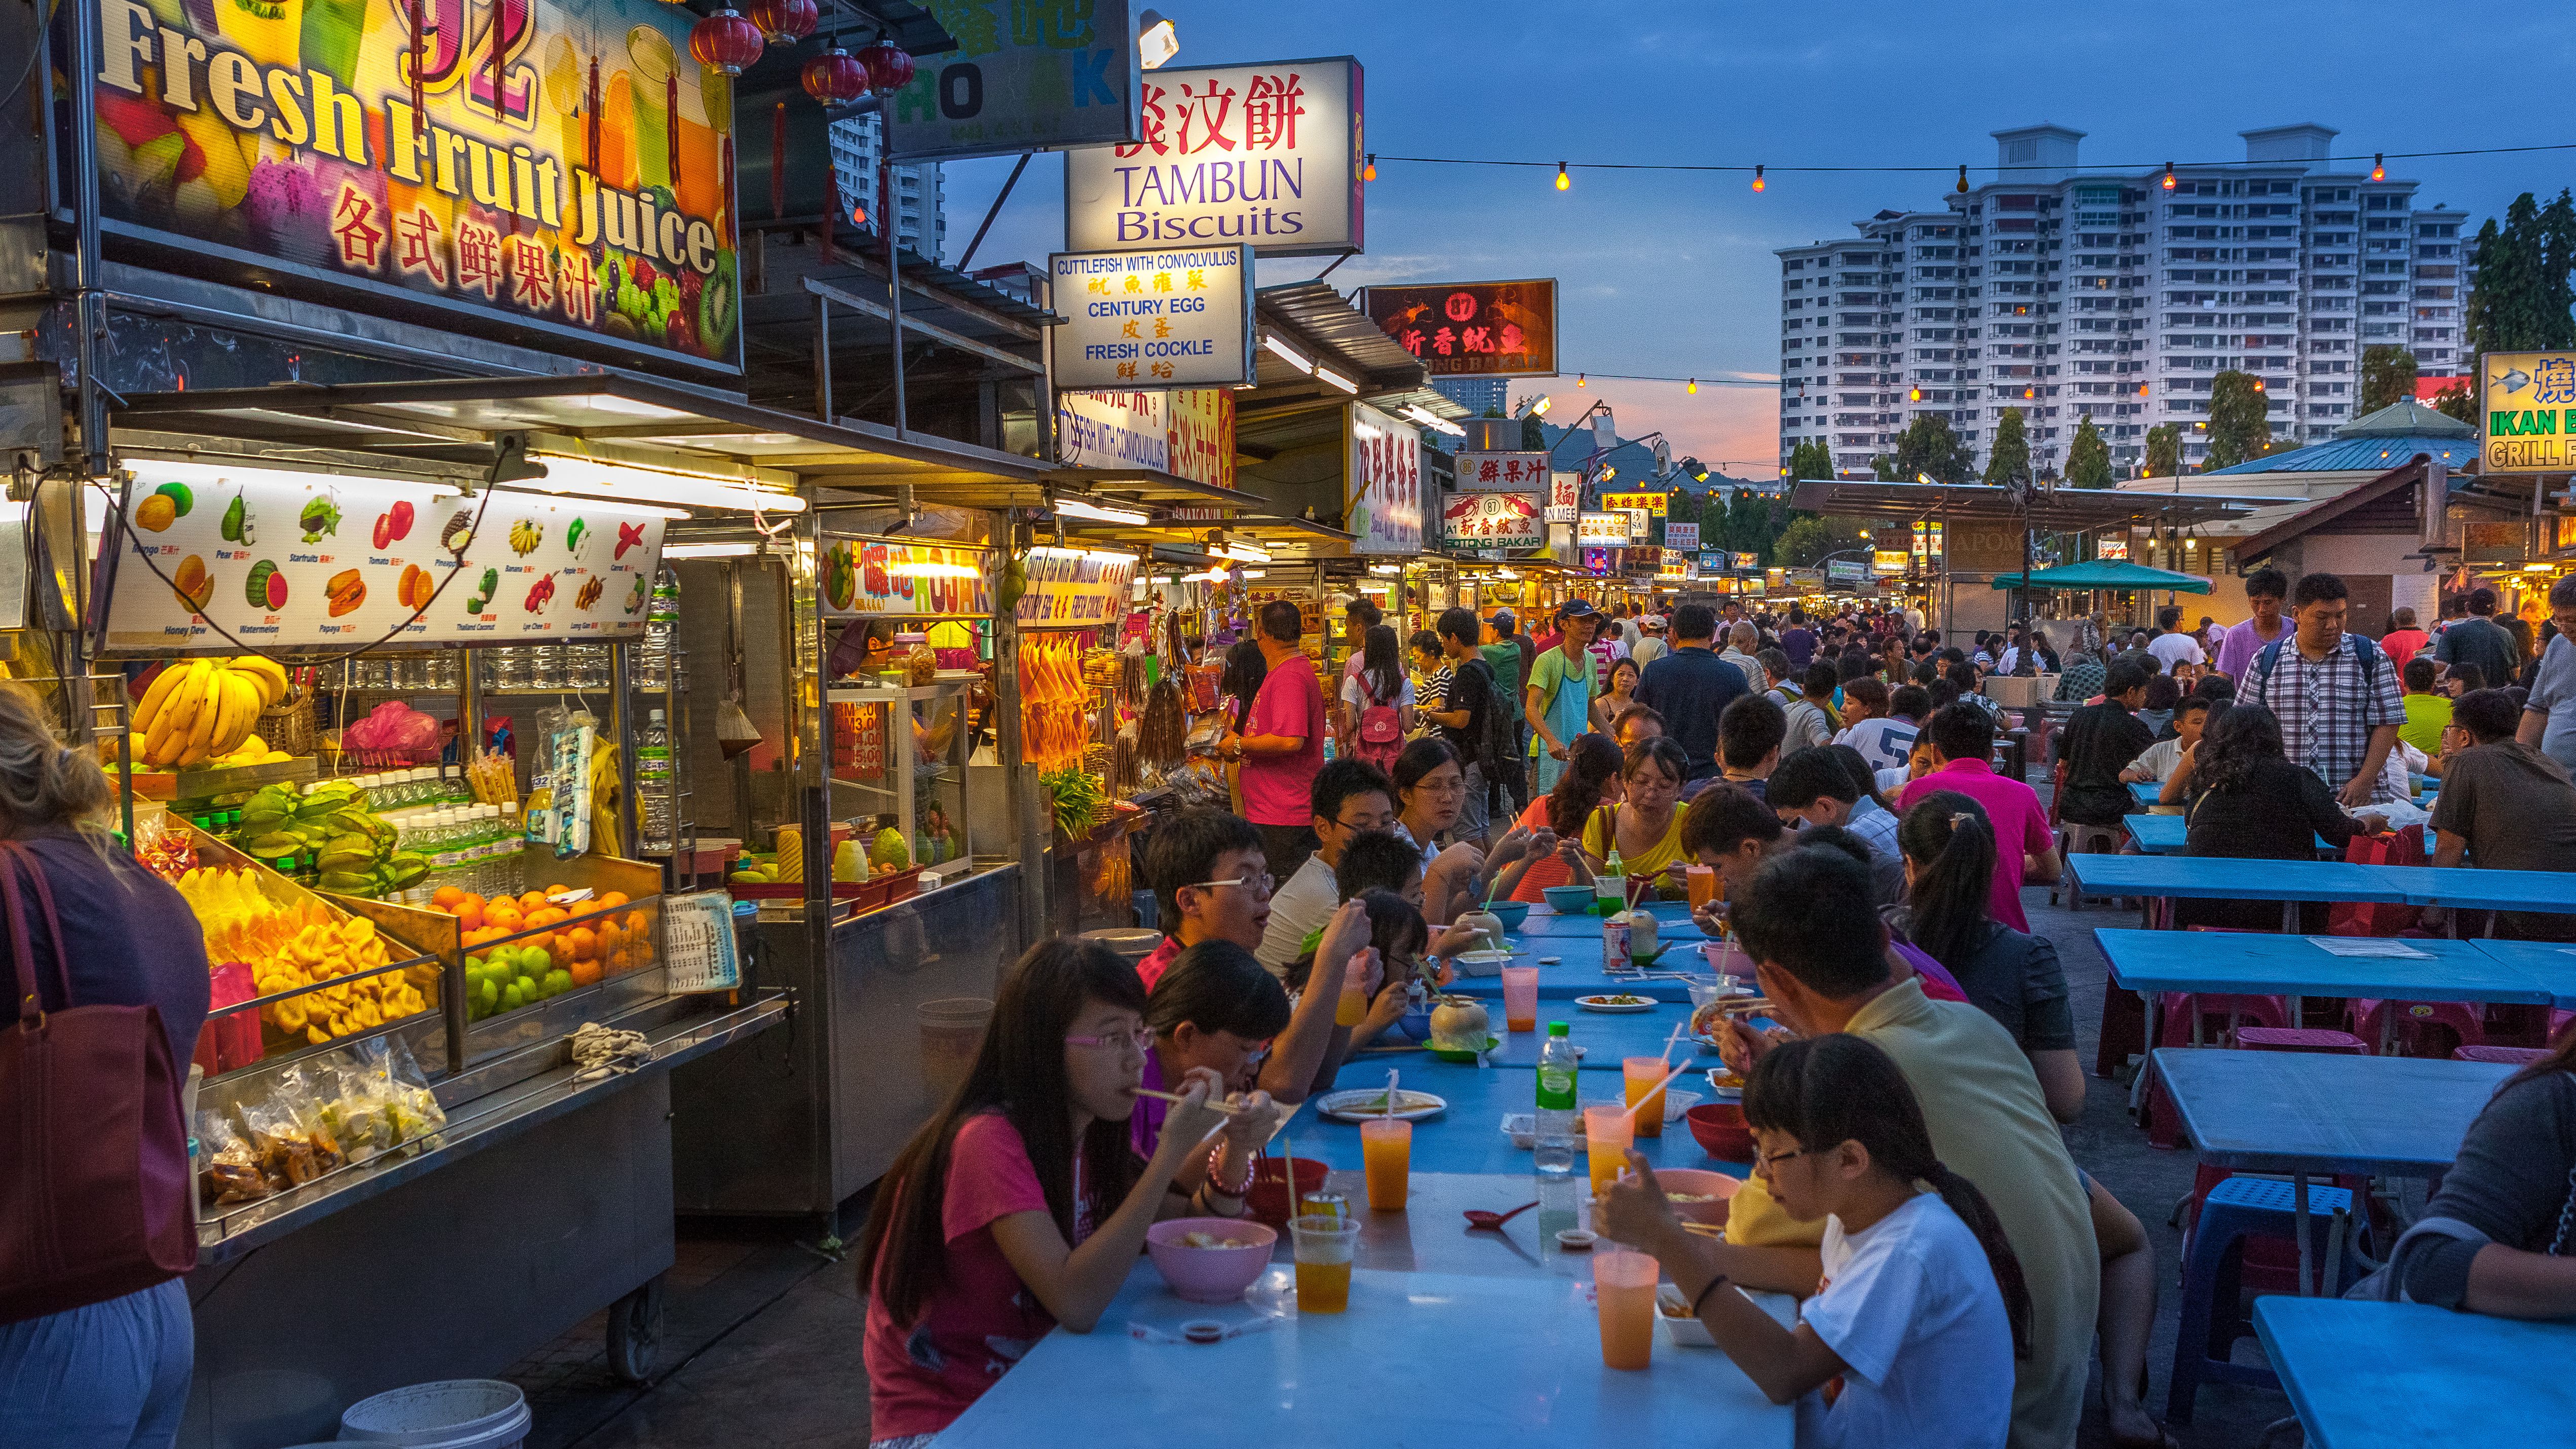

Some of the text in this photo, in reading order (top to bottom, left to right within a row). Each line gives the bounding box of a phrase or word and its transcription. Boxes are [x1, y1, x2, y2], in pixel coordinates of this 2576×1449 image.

[896, 48, 1119, 124] ROAK
[98, 0, 717, 275] Fresh Fruit Juice
[1114, 158, 1302, 208] TAMBUN
[1117, 207, 1303, 242] Biscuits
[332, 185, 600, 322] 各式鮮果汁
[1057, 250, 1237, 275] CUTTLEFISH WITH CONVOLVULUS
[1088, 297, 1205, 318] CENTURY EGG
[1121, 317, 1174, 339] 皮蛋
[1086, 339, 1213, 360] FRESH COCKLE
[1117, 360, 1175, 381] 鮮蛤
[2489, 409, 2556, 436] IKAN
[1097, 421, 1116, 457] WITH
[1117, 426, 1164, 470] CONVOLVULUS
[2488, 440, 2559, 468] GRILL
[1478, 458, 1547, 483] 鮮果汁
[1487, 502, 1496, 512] 87
[1557, 508, 1575, 520] MEE
[1445, 524, 1457, 535] A1
[1460, 516, 1533, 536] 新香魷魚
[1613, 513, 1629, 525] 82
[1445, 537, 1541, 548] SOTONG BAKAR
[216, 550, 232, 559] Pear
[289, 554, 318, 563] Starfruits
[368, 557, 389, 565] Tomato
[435, 559, 458, 569] Pineapp
[913, 547, 989, 613] ROJAK
[1070, 595, 1089, 619] FRESH
[164, 626, 207, 637] Honey Dew
[239, 625, 279, 634] Watermelon
[319, 624, 340, 634] Papaya
[406, 624, 427, 633] Orange
